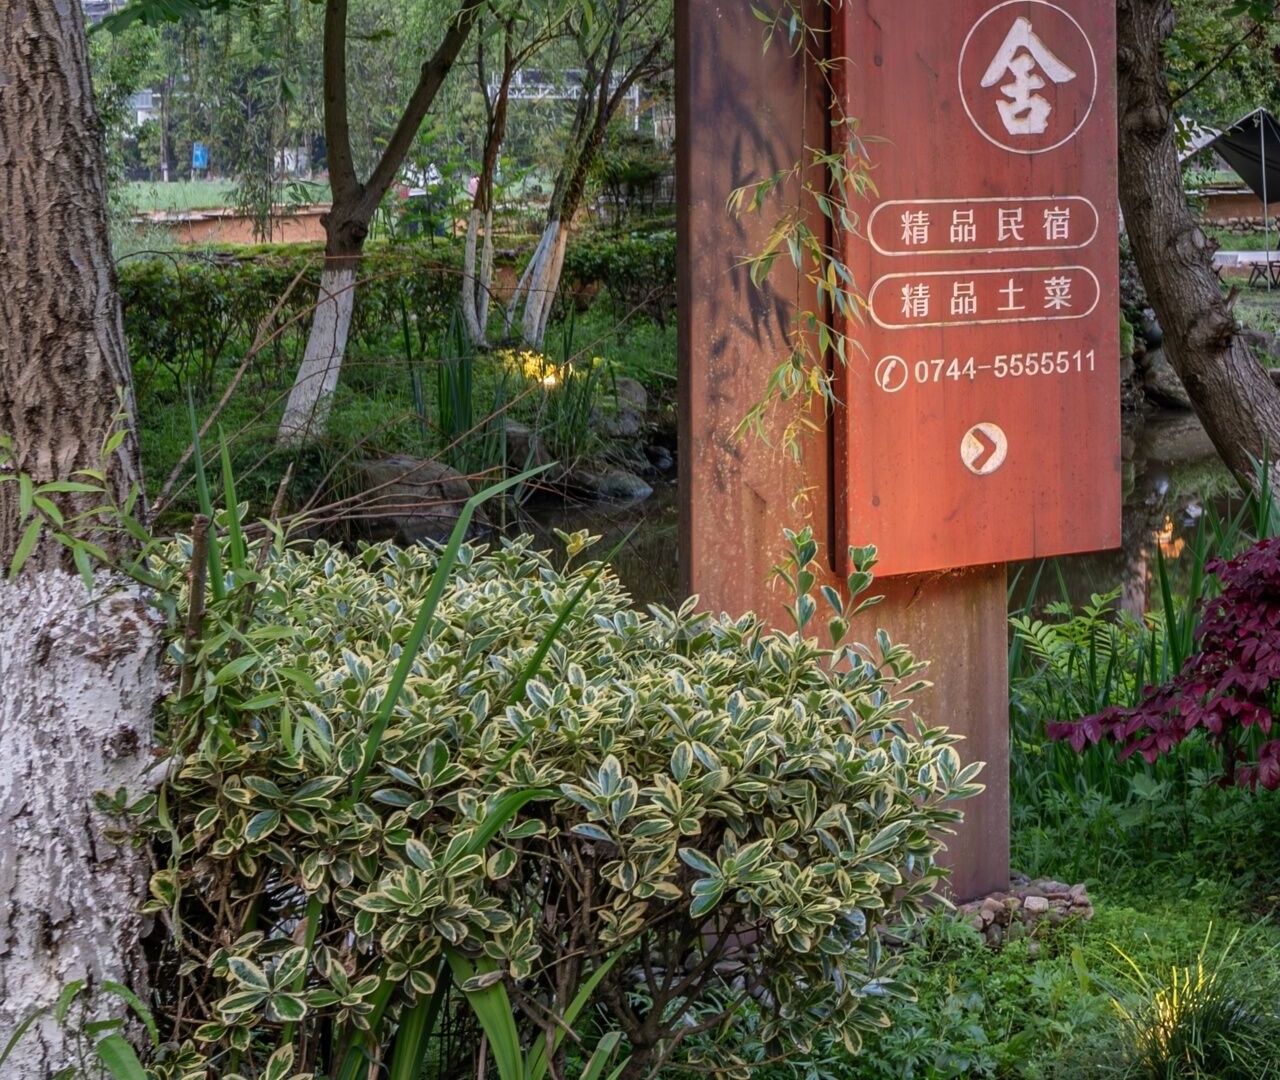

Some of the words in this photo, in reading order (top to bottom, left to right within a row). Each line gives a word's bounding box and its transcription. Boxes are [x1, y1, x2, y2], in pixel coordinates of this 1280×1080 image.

[901, 206, 1070, 245] 精品民宿
[901, 276, 1072, 318] 精品土菜
[914, 349, 1095, 383] 0744-5555511
